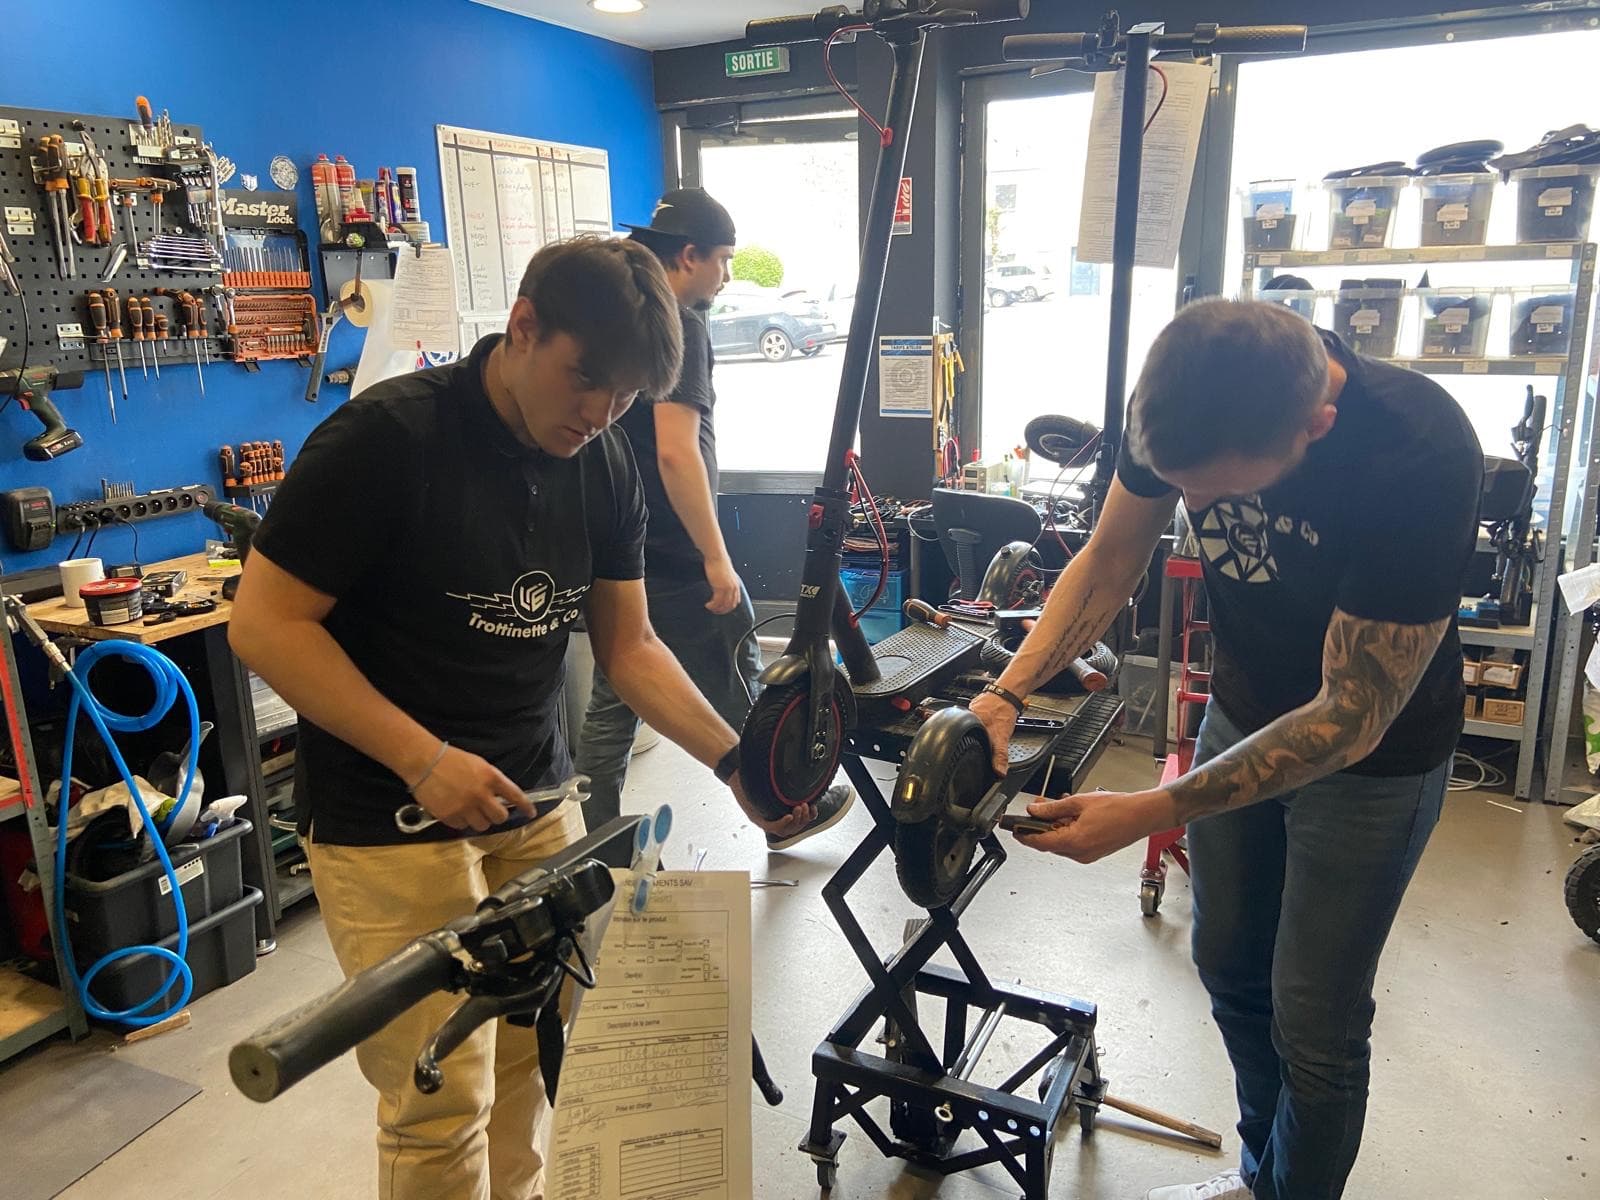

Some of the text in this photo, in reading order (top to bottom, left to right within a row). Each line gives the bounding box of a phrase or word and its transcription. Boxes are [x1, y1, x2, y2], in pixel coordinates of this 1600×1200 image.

[731, 51, 774, 72] SORTIE
[221, 197, 289, 217] Master
[266, 214, 294, 225] Lock
[468, 608, 579, 639] Trottinette & Co
